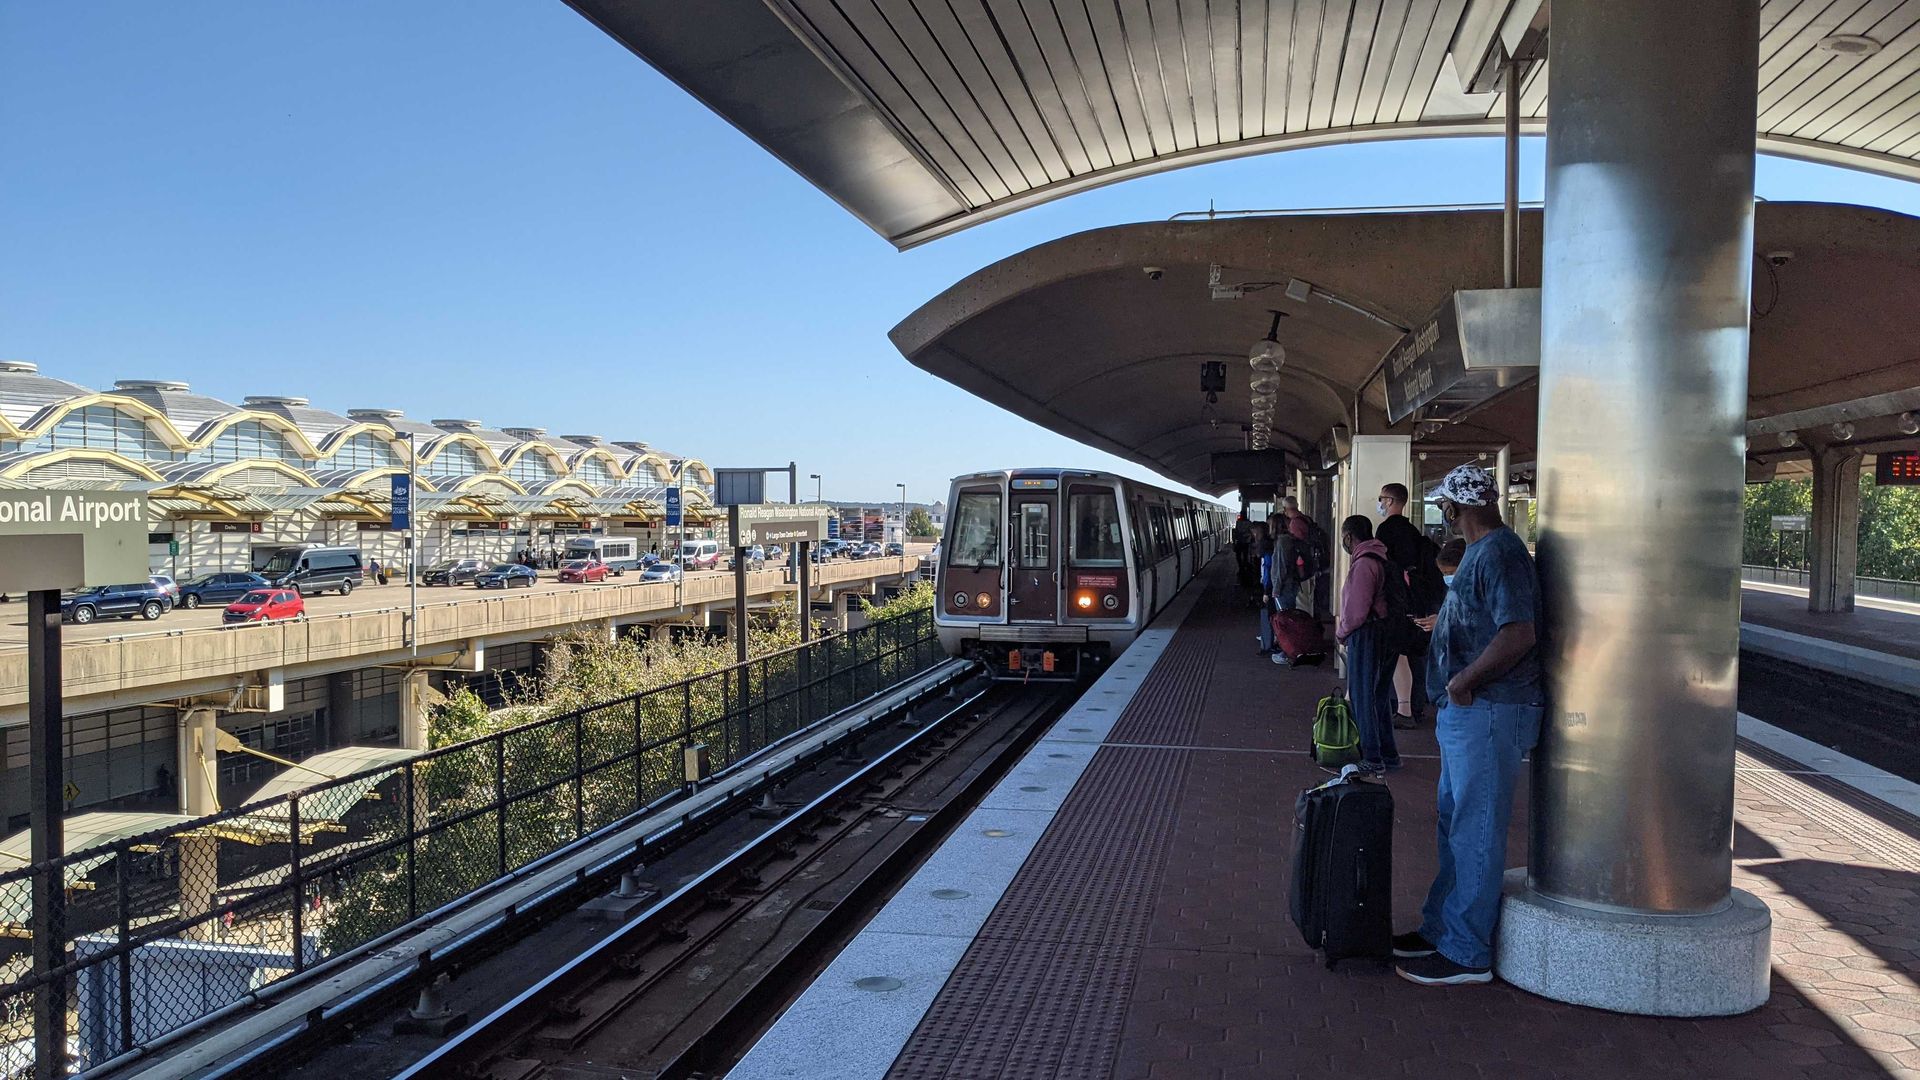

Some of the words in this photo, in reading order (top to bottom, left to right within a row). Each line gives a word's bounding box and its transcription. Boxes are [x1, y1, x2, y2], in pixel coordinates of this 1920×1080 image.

[1415, 320, 1440, 357] Washington
[1419, 362, 1434, 395] Airport
[0, 495, 52, 522] onal
[60, 495, 141, 528] Airport
[740, 507, 757, 519] Ronald
[758, 507, 775, 520] Reagan
[775, 506, 799, 520] Washington
[799, 506, 815, 517] National
[815, 506, 828, 518] Airport
